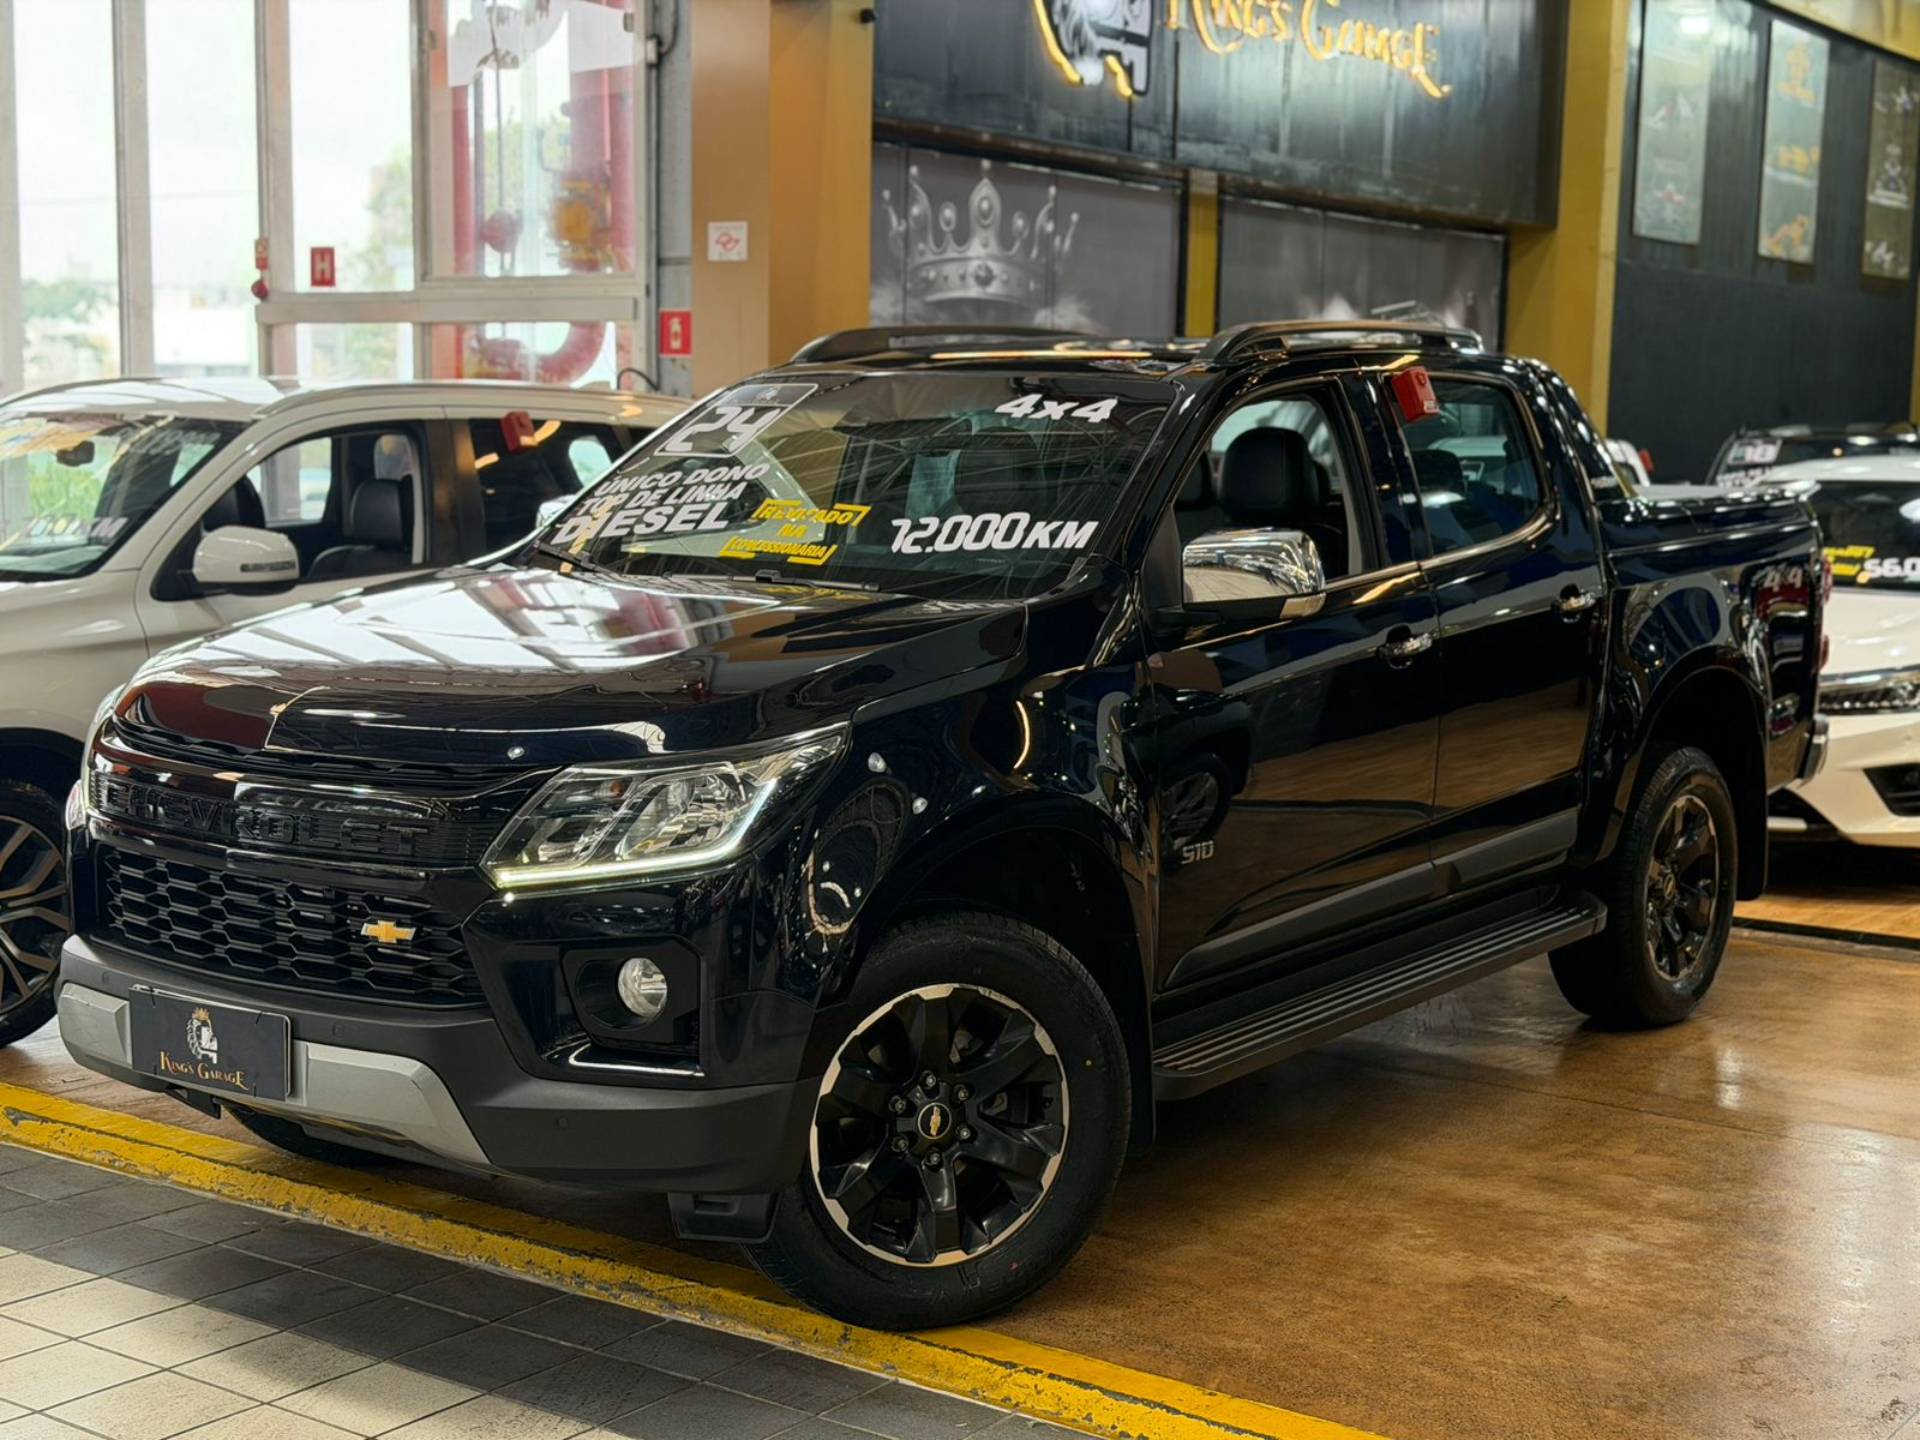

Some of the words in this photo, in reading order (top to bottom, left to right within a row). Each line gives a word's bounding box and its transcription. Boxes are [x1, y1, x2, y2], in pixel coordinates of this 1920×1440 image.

[665, 405, 781, 453] 24
[577, 492, 624, 516] TOP
[626, 488, 667, 509] DE
[666, 481, 748, 504] LINHA
[594, 470, 683, 497] ÚNICO
[684, 463, 770, 485] DONO
[550, 502, 730, 546] DIESEL
[104, 779, 429, 857] CHEVROLET
[197, 1063, 250, 1091] GARAGE
